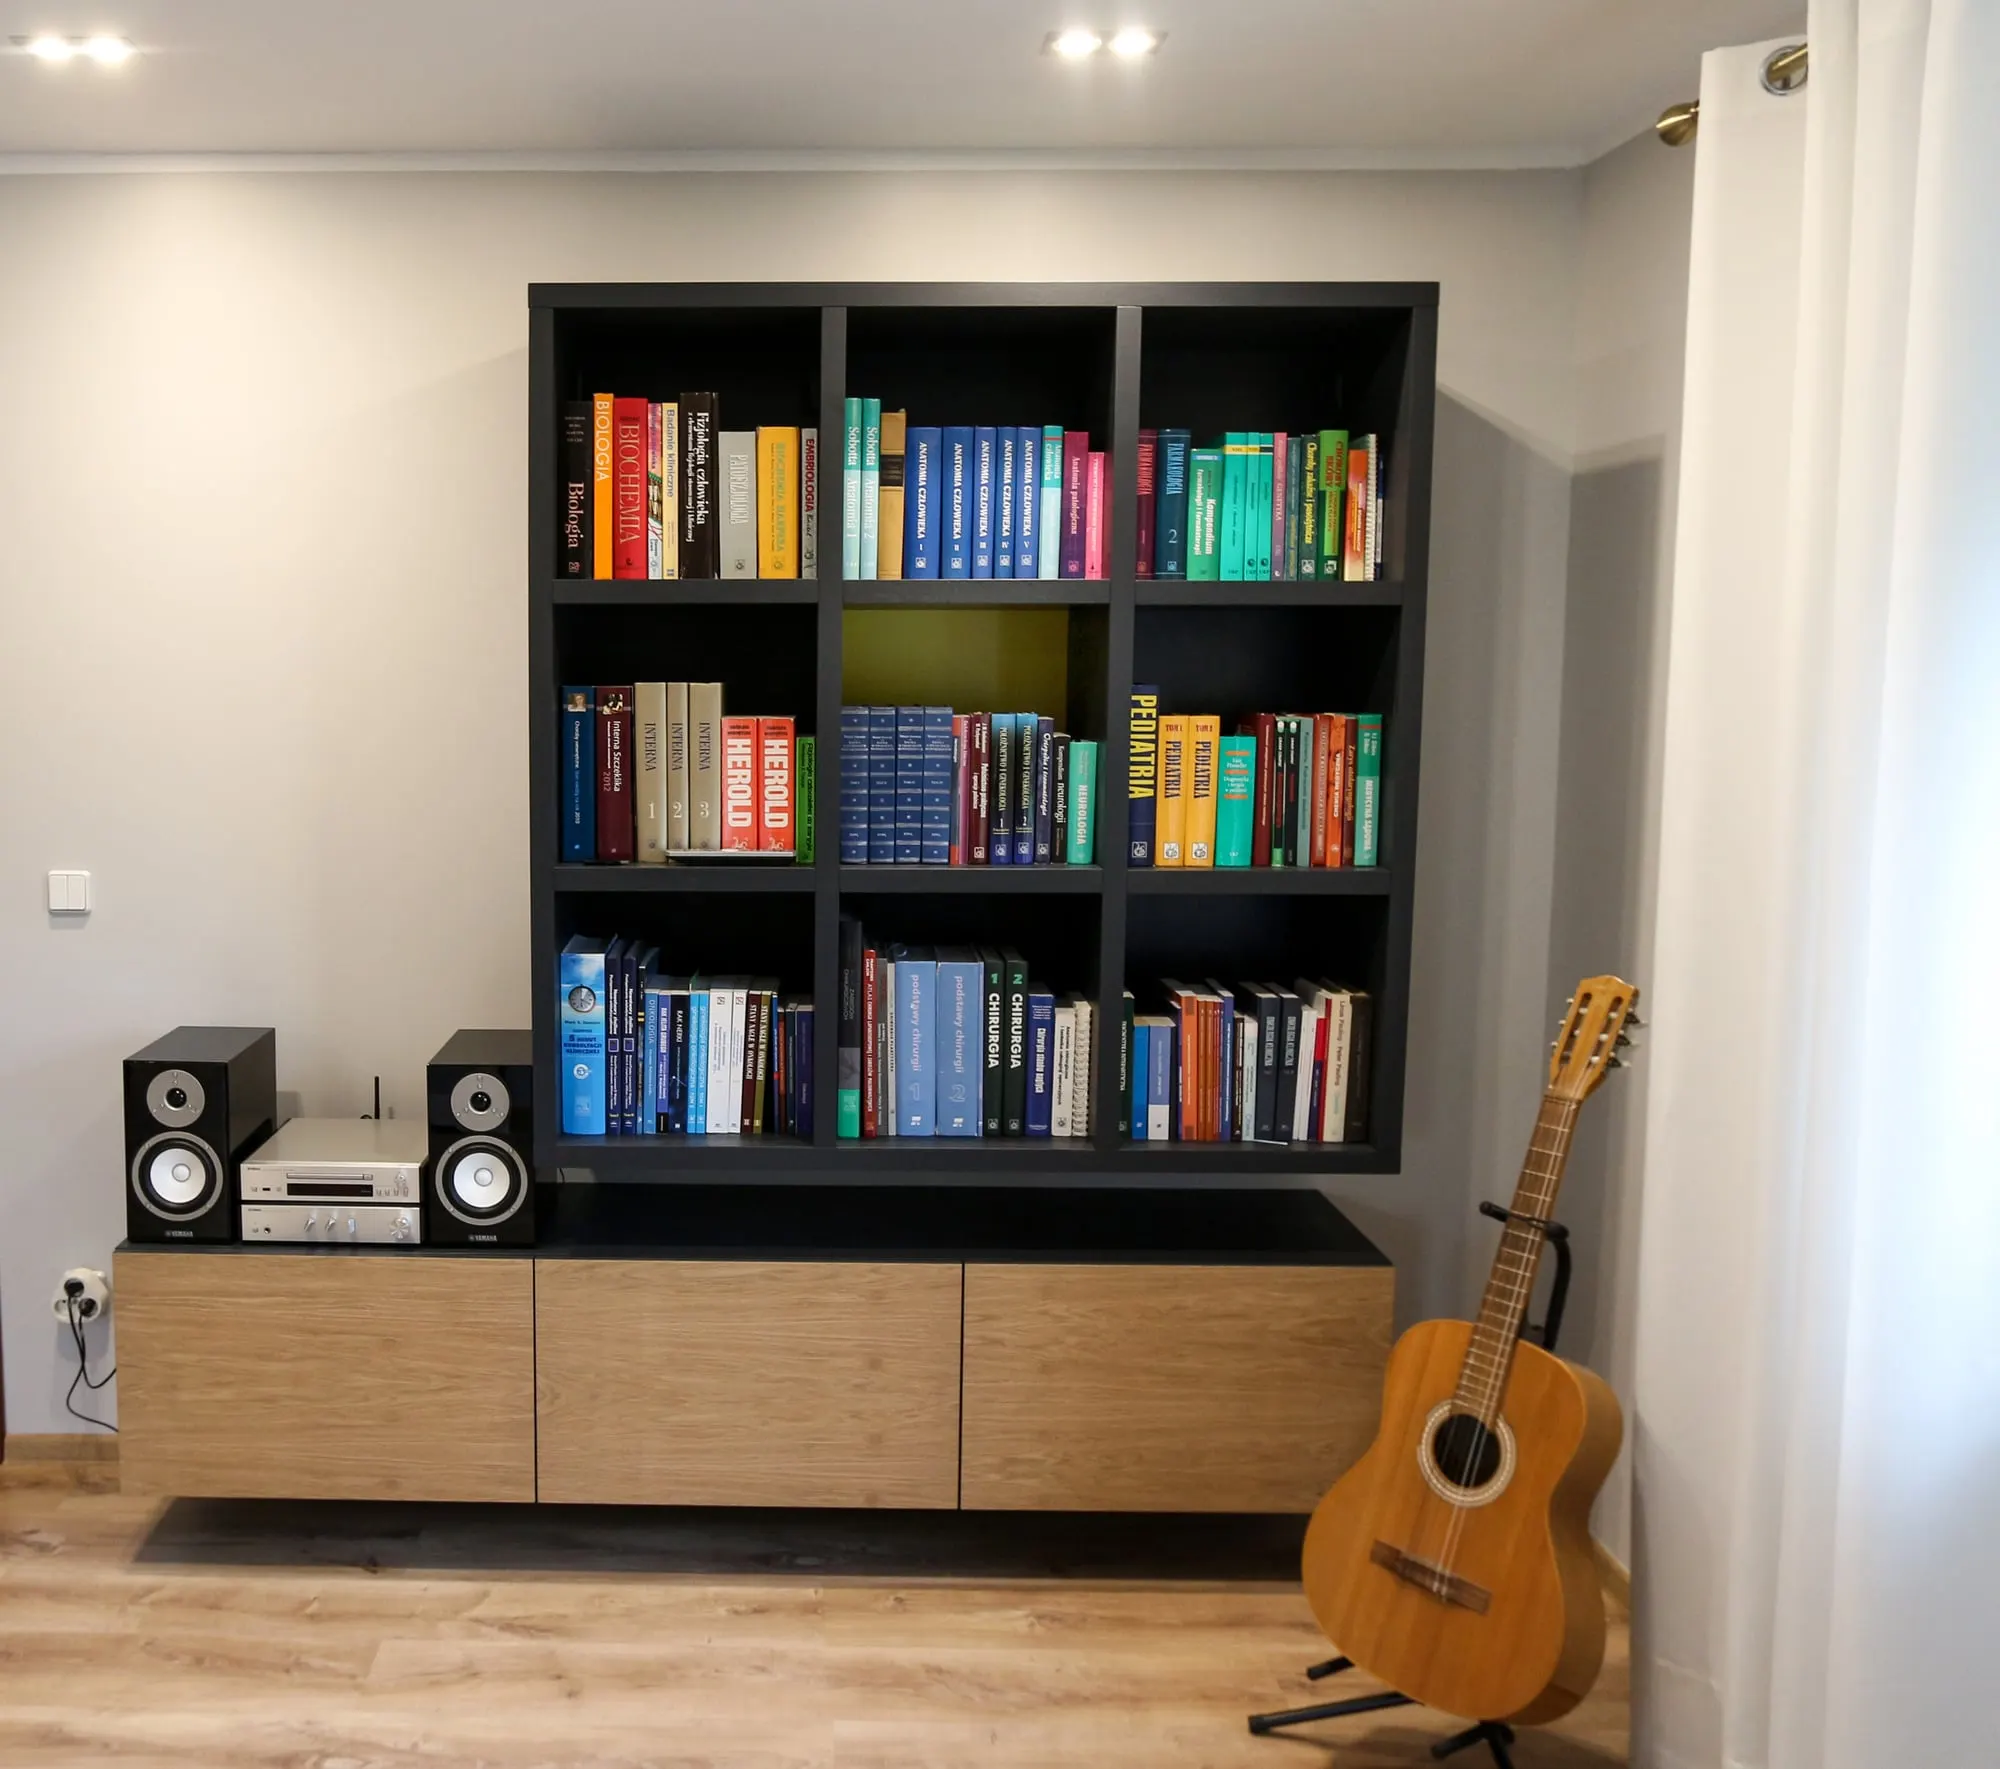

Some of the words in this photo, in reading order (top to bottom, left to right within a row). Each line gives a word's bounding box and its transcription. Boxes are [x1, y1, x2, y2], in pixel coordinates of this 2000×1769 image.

[596, 400, 611, 482] BIOLOGIA
[667, 409, 676, 450] Badanie
[694, 412, 710, 466] Fizjologia
[847, 426, 861, 466] Sobotta
[865, 426, 880, 466] Sobotta
[619, 424, 642, 544] BIOCHEMIA
[667, 453, 676, 498] kliniczne
[805, 438, 815, 512] EMBRIOLOGIA
[918, 441, 928, 486] ANATOMIA
[953, 443, 963, 487] ANATOMIA
[980, 440, 990, 484] ANATOMIA
[1002, 440, 1012, 484] ANATOMIA
[1024, 440, 1033, 484] ANATOMIA
[1071, 456, 1081, 489] Anatomia
[1137, 444, 1154, 495] FARMAKOLOGIA
[1166, 443, 1185, 495] FARMAKOLOGIA
[696, 468, 709, 525] człowieka
[729, 454, 749, 524] PATOFIZJOLOGIA
[846, 478, 859, 529] Anatomia
[979, 486, 989, 537] CZŁOWIEKA
[1001, 485, 1011, 537] CZŁOWIEKA
[1023, 485, 1033, 537] CZŁOWIEKA
[565, 482, 585, 549] Biologia
[916, 488, 927, 539] CZŁOWIEKA
[952, 488, 962, 539] CZŁOWIEKA
[1069, 490, 1081, 535] patologiczna
[1204, 498, 1217, 555] Kompendium
[1168, 529, 1178, 543] 2
[613, 720, 622, 750] Interna
[645, 723, 657, 772] INTERNA
[672, 722, 683, 771] INTERNA
[699, 722, 711, 771] INTERNA
[1042, 733, 1051, 766] Ortopedia
[1129, 694, 1157, 799] PEDIATRIA
[603, 771, 611, 792] 2012
[613, 752, 622, 792] Szczeklika
[727, 738, 752, 828] HEROLD
[764, 739, 789, 829] HEROLD
[1056, 745, 1066, 780] Kompendium
[1164, 740, 1182, 799] PEDIATRIA
[1193, 741, 1212, 799] PEDIATRIA
[649, 802, 655, 819] 1
[673, 801, 682, 818] 2
[699, 801, 710, 819] 3
[1040, 771, 1049, 816] traumatologia
[1055, 782, 1067, 823] neurologii
[1076, 784, 1088, 845] NEUROLOGIA
[910, 974, 922, 1025] podstawy
[954, 975, 966, 1027] podstawy
[991, 973, 998, 984] 1
[1012, 974, 1023, 984] 2
[649, 999, 657, 1044] ONKOLOGIA
[676, 1010, 684, 1023] RAK
[760, 1005, 769, 1023] STANY
[988, 993, 1000, 1069] CHIRURGIA
[1010, 993, 1023, 1069] CHIRURGIA
[911, 1028, 923, 1071] chirurgii
[954, 1030, 966, 1074] chirurgii
[1035, 1028, 1046, 1053] Chirurgia
[1336, 1046, 1344, 1061] Peter
[910, 1083, 920, 1101] 1
[949, 1084, 966, 1103] 2
[1334, 1064, 1342, 1086] Pauling
